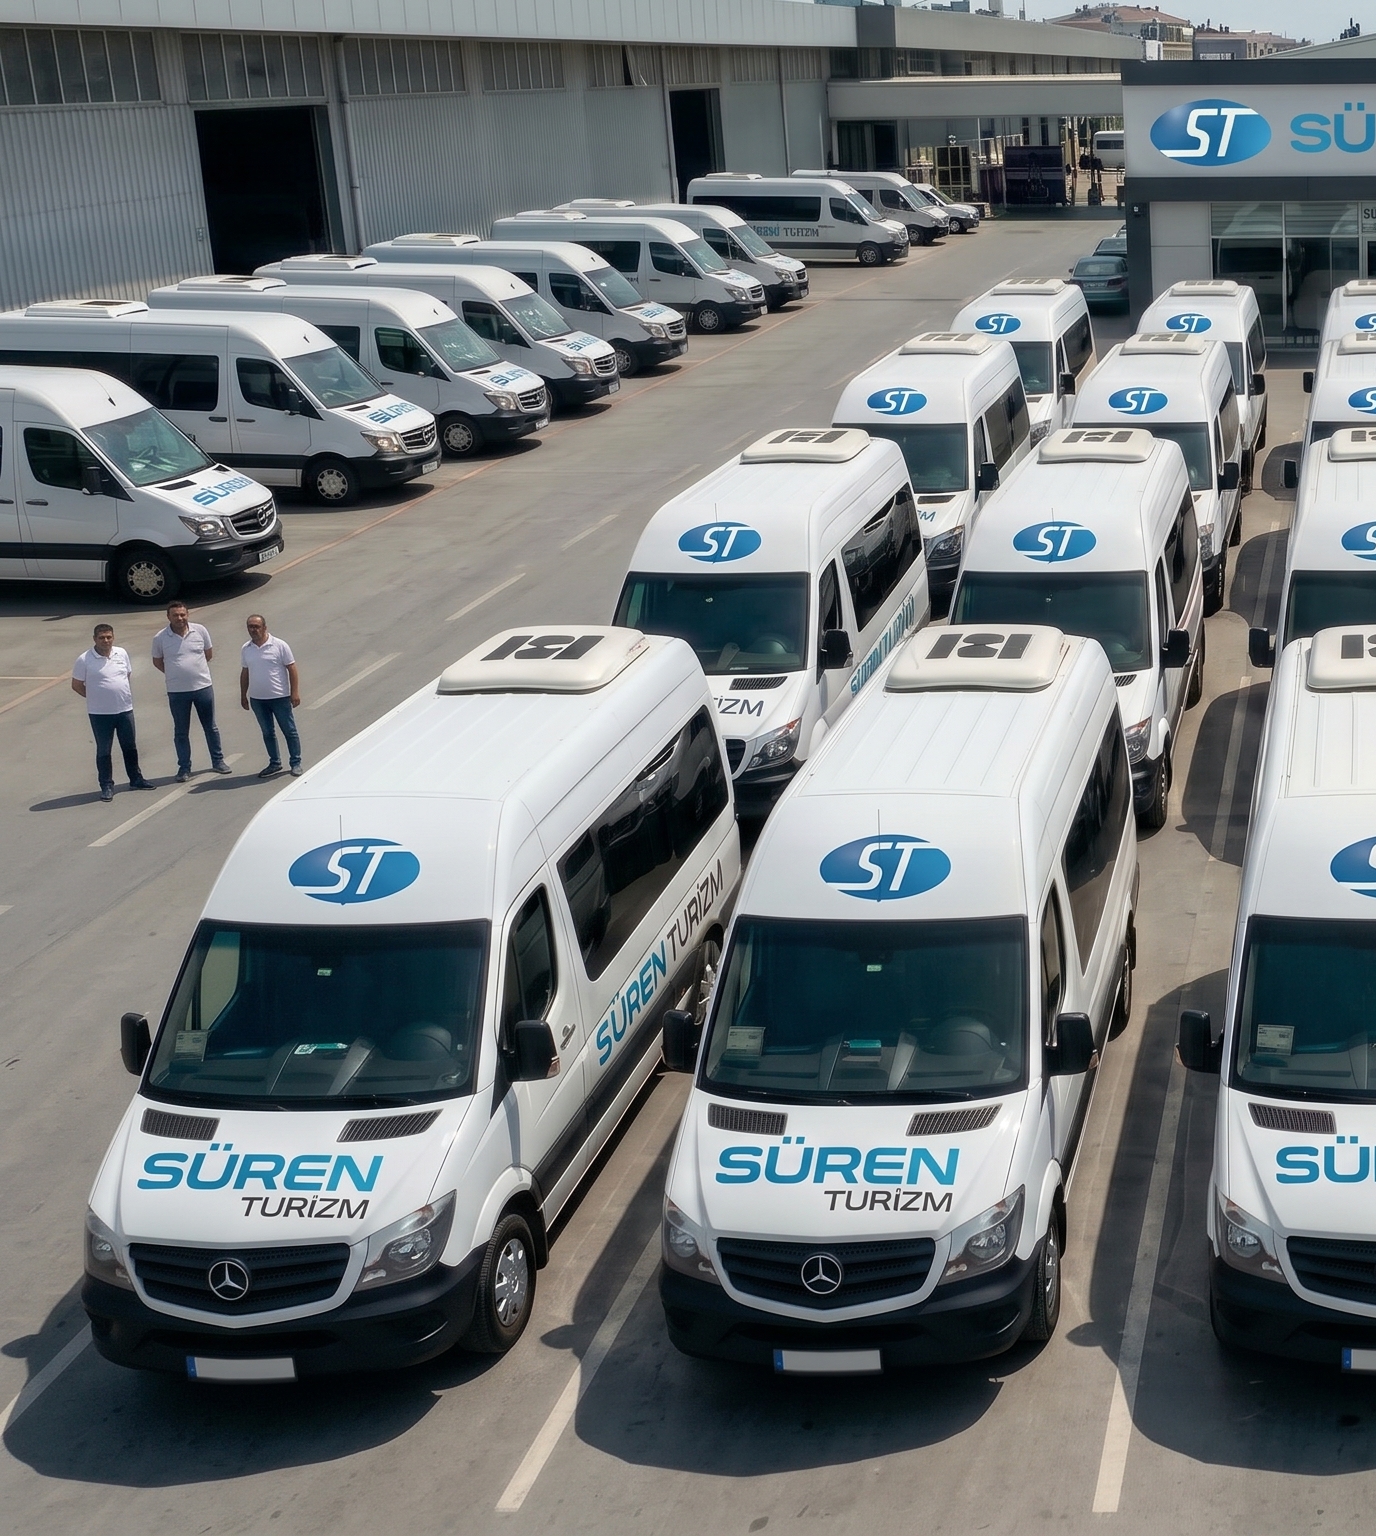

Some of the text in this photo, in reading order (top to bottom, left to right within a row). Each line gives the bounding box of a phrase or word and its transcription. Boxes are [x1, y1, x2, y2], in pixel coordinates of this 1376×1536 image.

[1159, 107, 1263, 158] ST
[978, 318, 1017, 332] ST
[1169, 317, 1208, 331] ST
[870, 393, 923, 412] ST
[1112, 393, 1163, 412] ST
[682, 528, 755, 557] ST
[1017, 528, 1090, 557] ST
[713, 695, 764, 717] İZM
[295, 847, 411, 895] ST
[826, 844, 942, 892] ST
[596, 858, 724, 1066] SÜREN TURİZM
[138, 1143, 383, 1191] SÜREN
[715, 1136, 959, 1185] SÜREN
[241, 1194, 371, 1220] TURİZM
[823, 1187, 953, 1213] TURİZM
